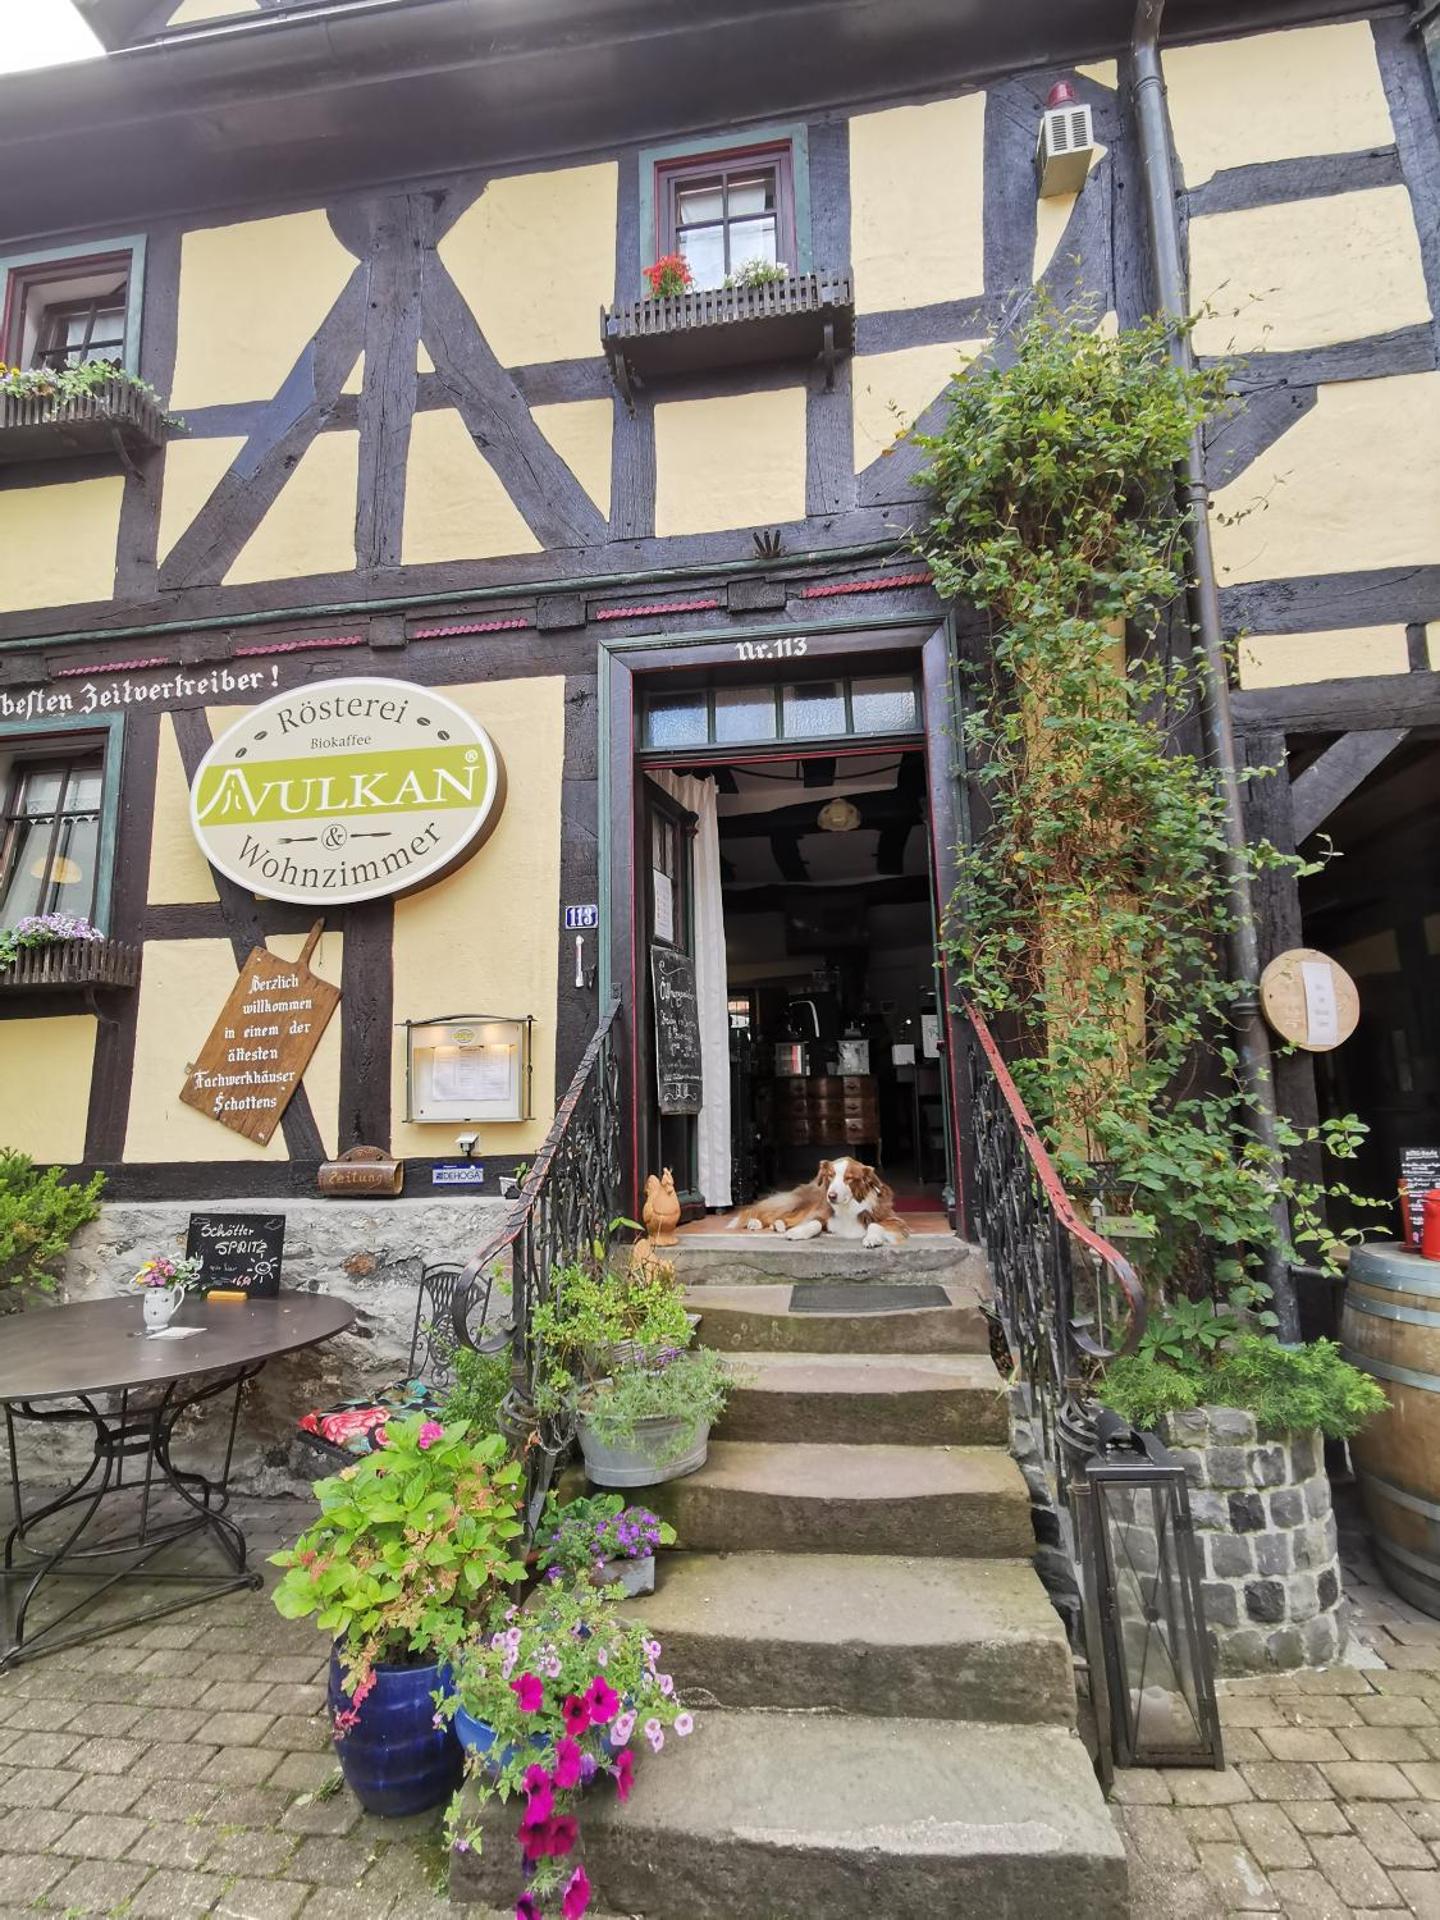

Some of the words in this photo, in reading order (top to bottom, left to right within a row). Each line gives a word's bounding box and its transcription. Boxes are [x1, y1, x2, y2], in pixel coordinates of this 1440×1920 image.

[277, 696, 409, 735] Rösterei
[310, 734, 373, 750] Biokaffee
[238, 820, 441, 889] Wohnzimmer
[569, 907, 594, 926] 113
[249, 974, 299, 994] Herzlich
[242, 999, 313, 1015] willkommen
[224, 1027, 236, 1039] in
[243, 1024, 280, 1038] einem
[288, 1020, 312, 1034] der
[194, 1070, 296, 1090] Fachwerkhäuser
[213, 1091, 278, 1114] Schottens
[328, 1170, 384, 1189] Zeitung
[442, 1170, 482, 1182] DEHOGA
[214, 1240, 268, 1256] SPRITZ
